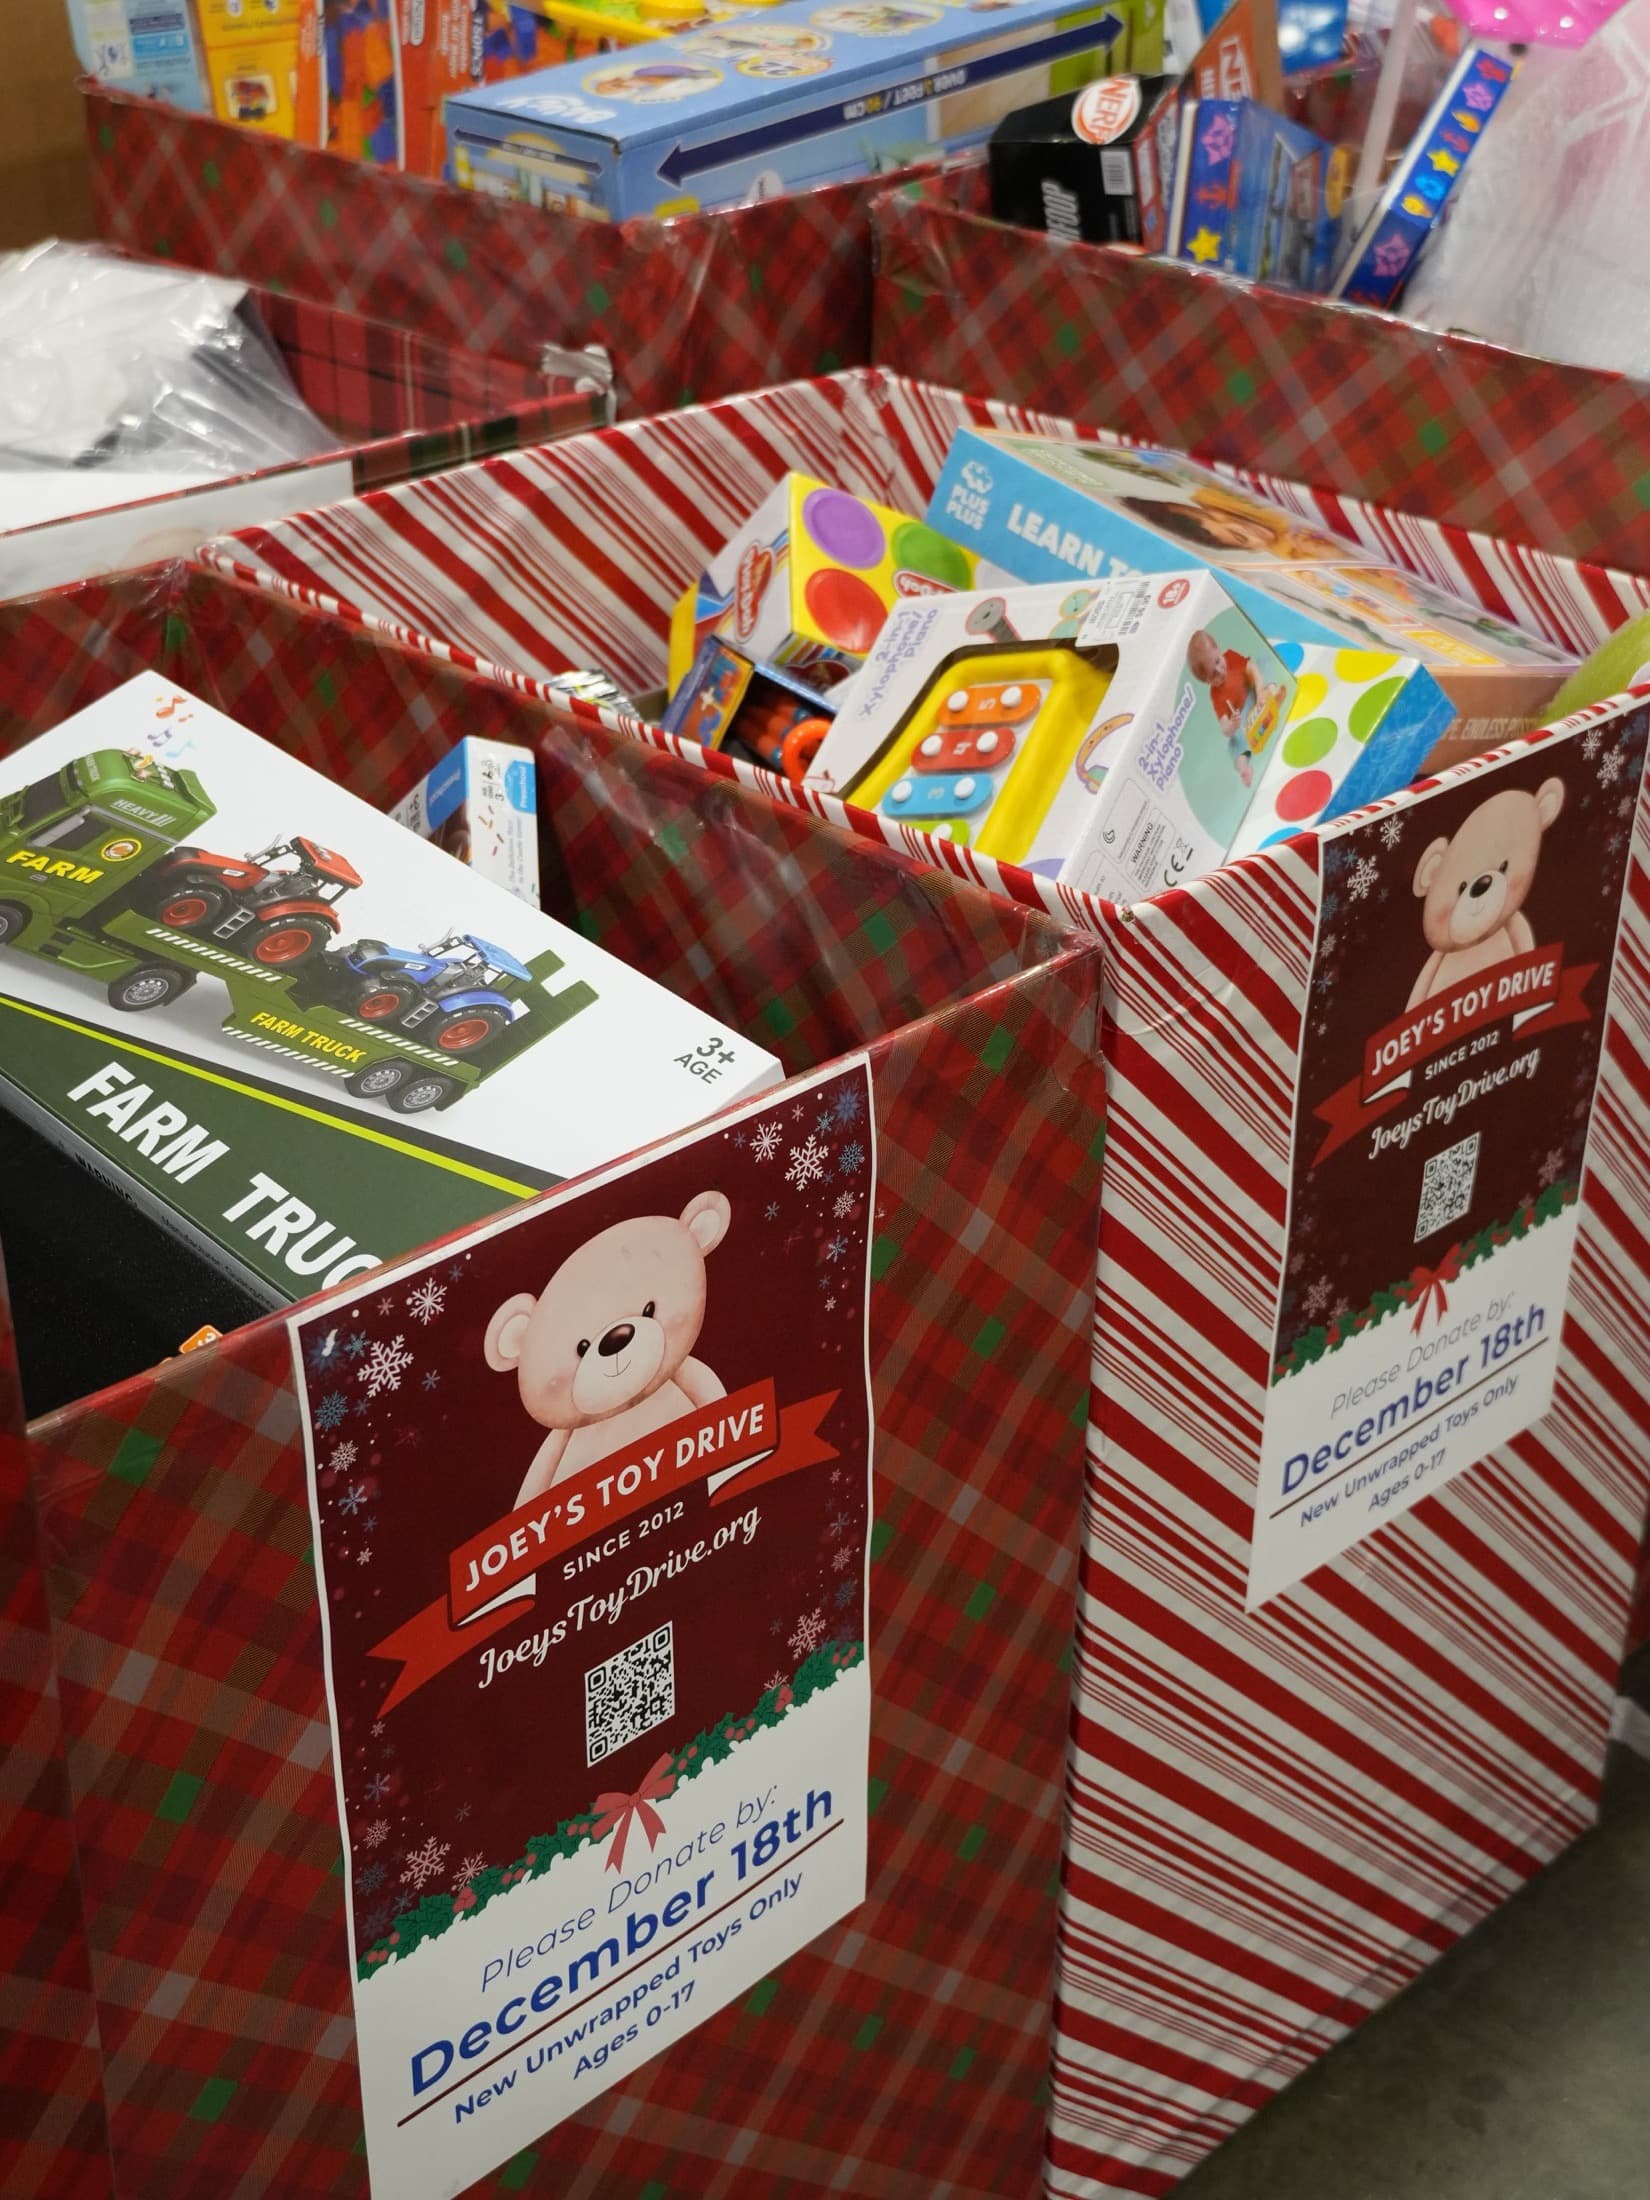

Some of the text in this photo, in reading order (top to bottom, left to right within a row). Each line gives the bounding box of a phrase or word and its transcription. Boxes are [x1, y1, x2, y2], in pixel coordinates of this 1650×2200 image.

[1090, 78, 1133, 142] NERF
[945, 499, 985, 532] PLUS
[950, 484, 991, 516] PLUS
[1006, 503, 1106, 578] LEARN
[1137, 721, 1165, 771] 2-in-1
[112, 799, 160, 823] HEAVY
[1130, 822, 1155, 864] WARNING
[6, 850, 104, 884] FARM
[250, 1012, 367, 1064] FARM TRUCK
[696, 1037, 737, 1067] 3+
[1371, 961, 1556, 1077] JOEY'S TOY DRIVE
[673, 1052, 724, 1085] AGE
[1424, 1030, 1500, 1081] SINCE 2012
[66, 1061, 231, 1185] FARM
[1330, 1290, 1515, 1420] Please Donate by:
[1280, 1303, 1546, 1496] December 18th
[1300, 1374, 1519, 1528] New Unwrapped Toys Only
[1367, 1447, 1447, 1513] Ages 0-17
[464, 1402, 765, 1592] JOEY'S TOY DRIVE
[562, 1501, 685, 1581] SINCE 2012
[480, 1783, 779, 1993] Please Donate by:
[410, 1789, 834, 2097] December 18th
[453, 1872, 803, 2125] New Unwrapped Toys Only
[572, 1979, 696, 2081] Ages 0-17
